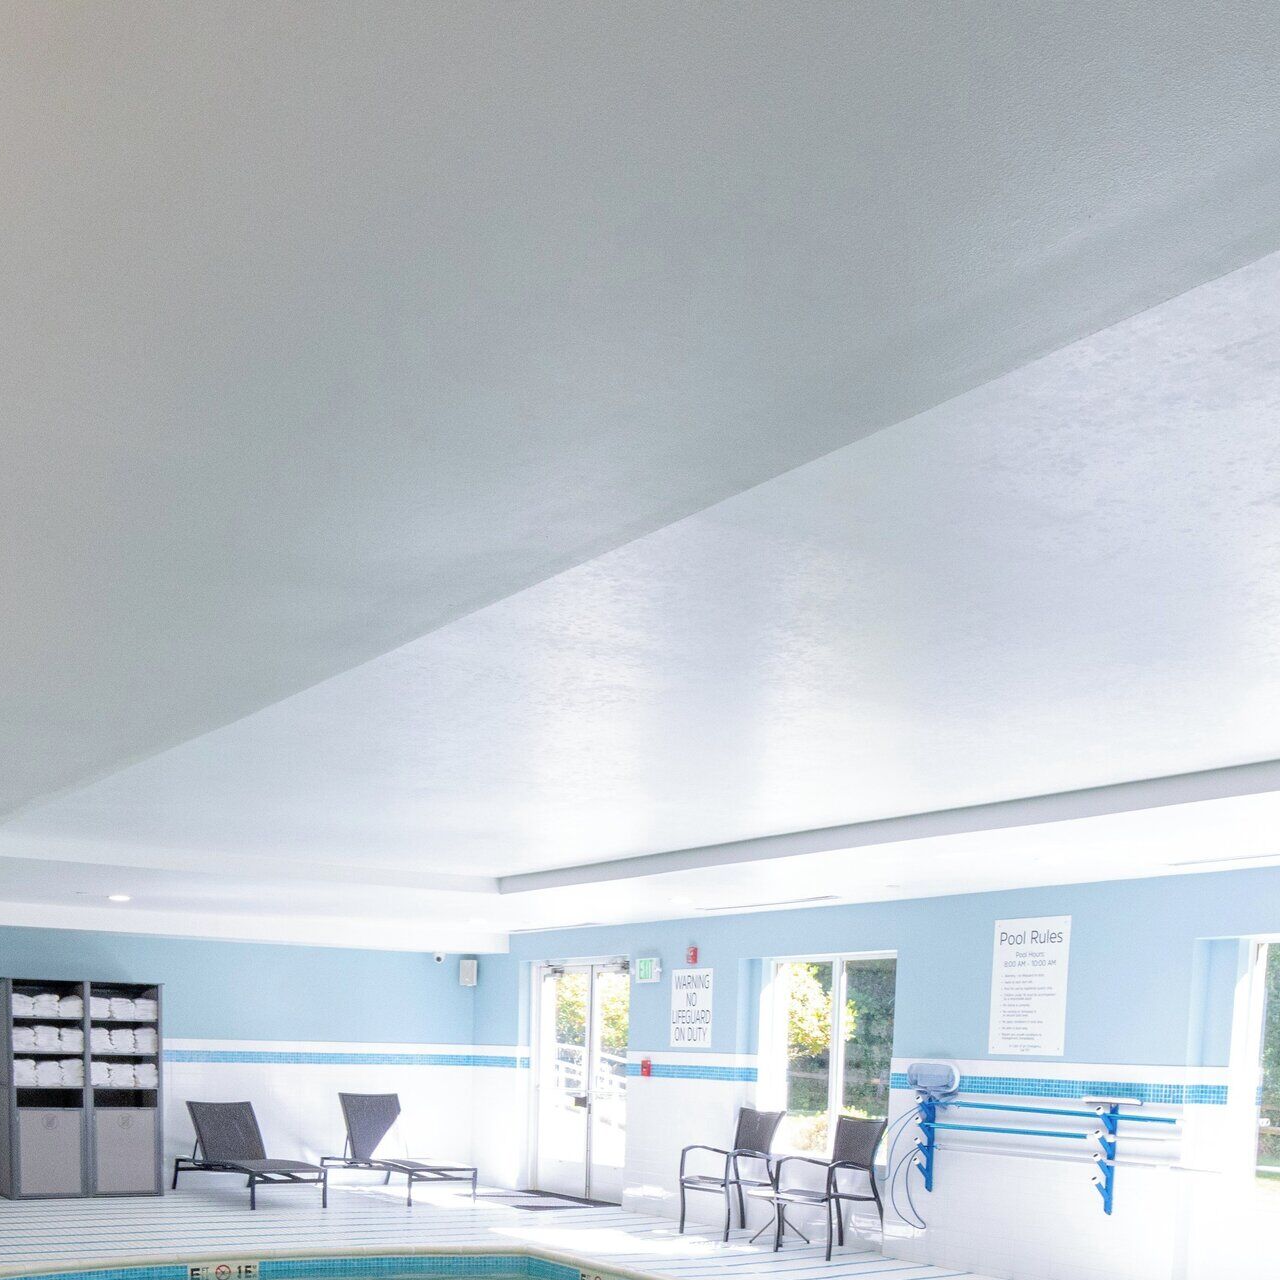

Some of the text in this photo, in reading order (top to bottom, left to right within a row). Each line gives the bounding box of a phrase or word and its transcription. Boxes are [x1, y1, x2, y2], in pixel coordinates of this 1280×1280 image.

[1000, 929, 1064, 946] Pool Rules
[675, 974, 710, 990] WARNING
[686, 992, 697, 1007] NO
[672, 1009, 711, 1024] LIFEGUARD
[675, 1026, 708, 1042] ON DUTY
